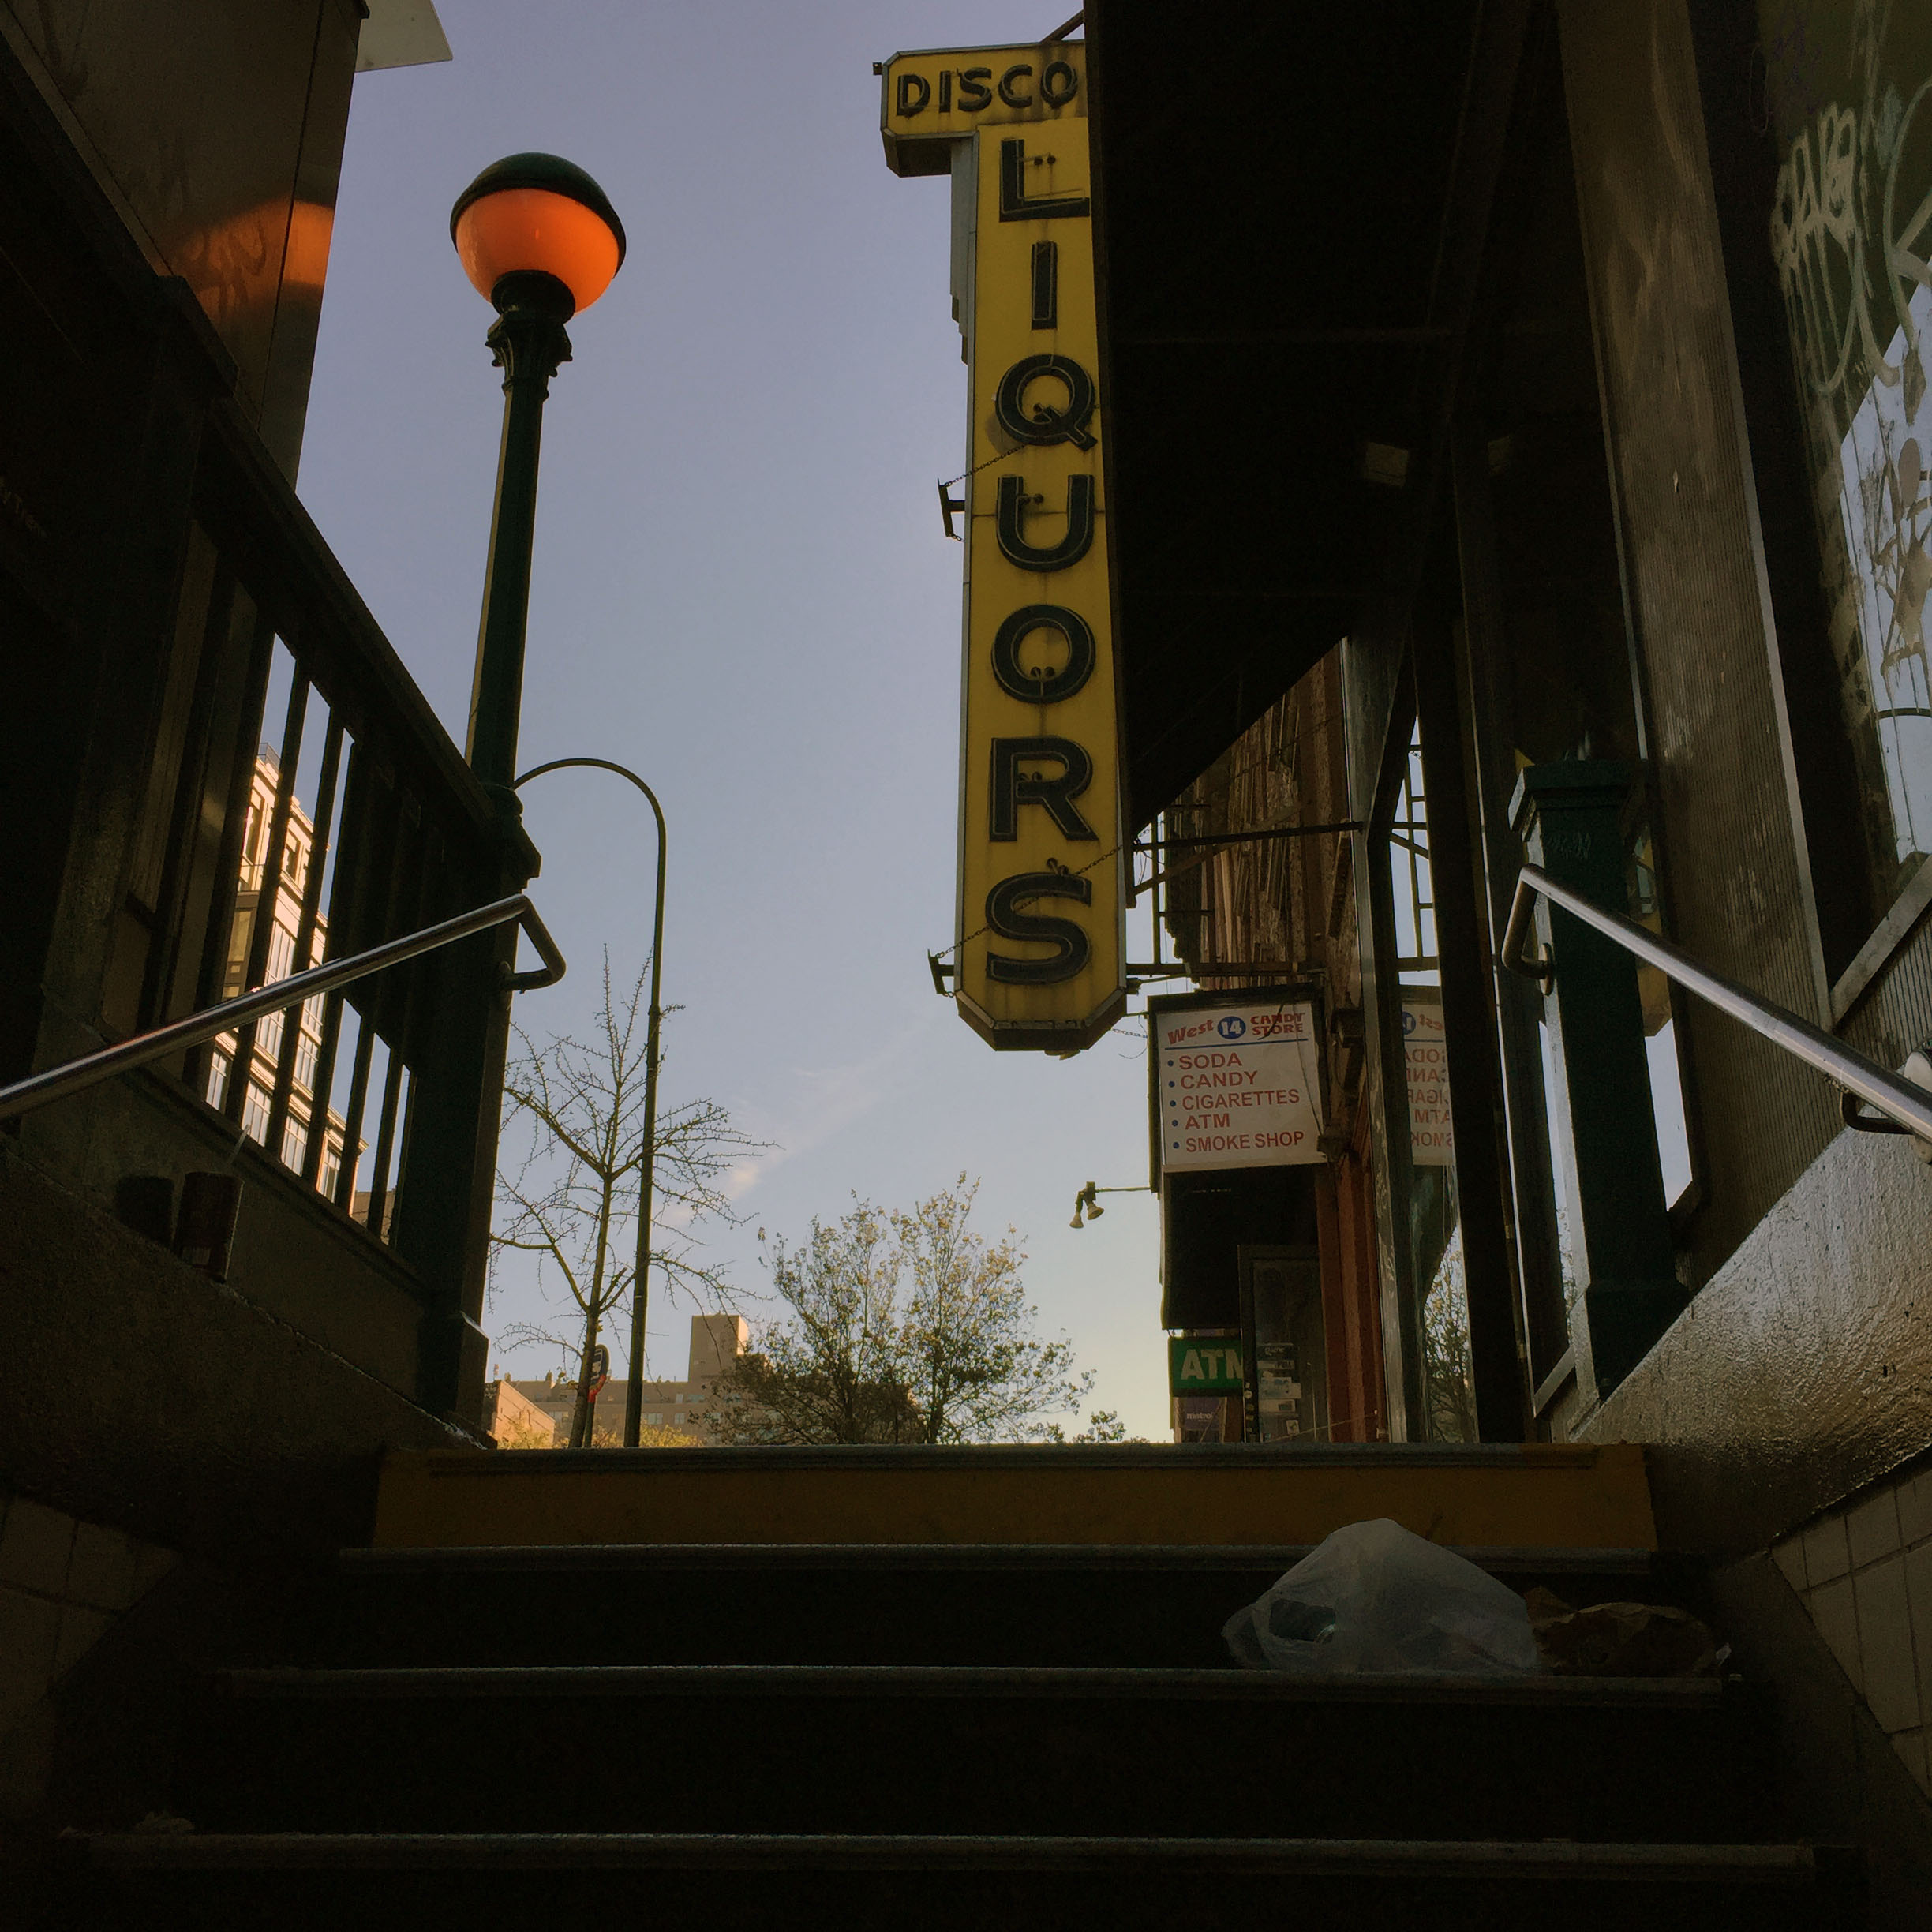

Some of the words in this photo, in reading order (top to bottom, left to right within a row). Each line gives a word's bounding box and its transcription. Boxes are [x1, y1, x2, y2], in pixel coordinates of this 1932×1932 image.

[897, 61, 1078, 117] DISCO
[984, 137, 1099, 986] LIQUORS
[1168, 1019, 1214, 1045] West
[1220, 1020, 1242, 1035] 14
[1250, 1013, 1305, 1025] CANDY
[1252, 1024, 1303, 1036] STORE
[1178, 1052, 1243, 1070] SODA
[1180, 1070, 1258, 1089] CANDY
[1182, 1088, 1301, 1110] CIGARETTES
[1185, 1113, 1230, 1130] ATM
[1185, 1134, 1251, 1152] SMOKE
[1254, 1130, 1305, 1148] SHOP
